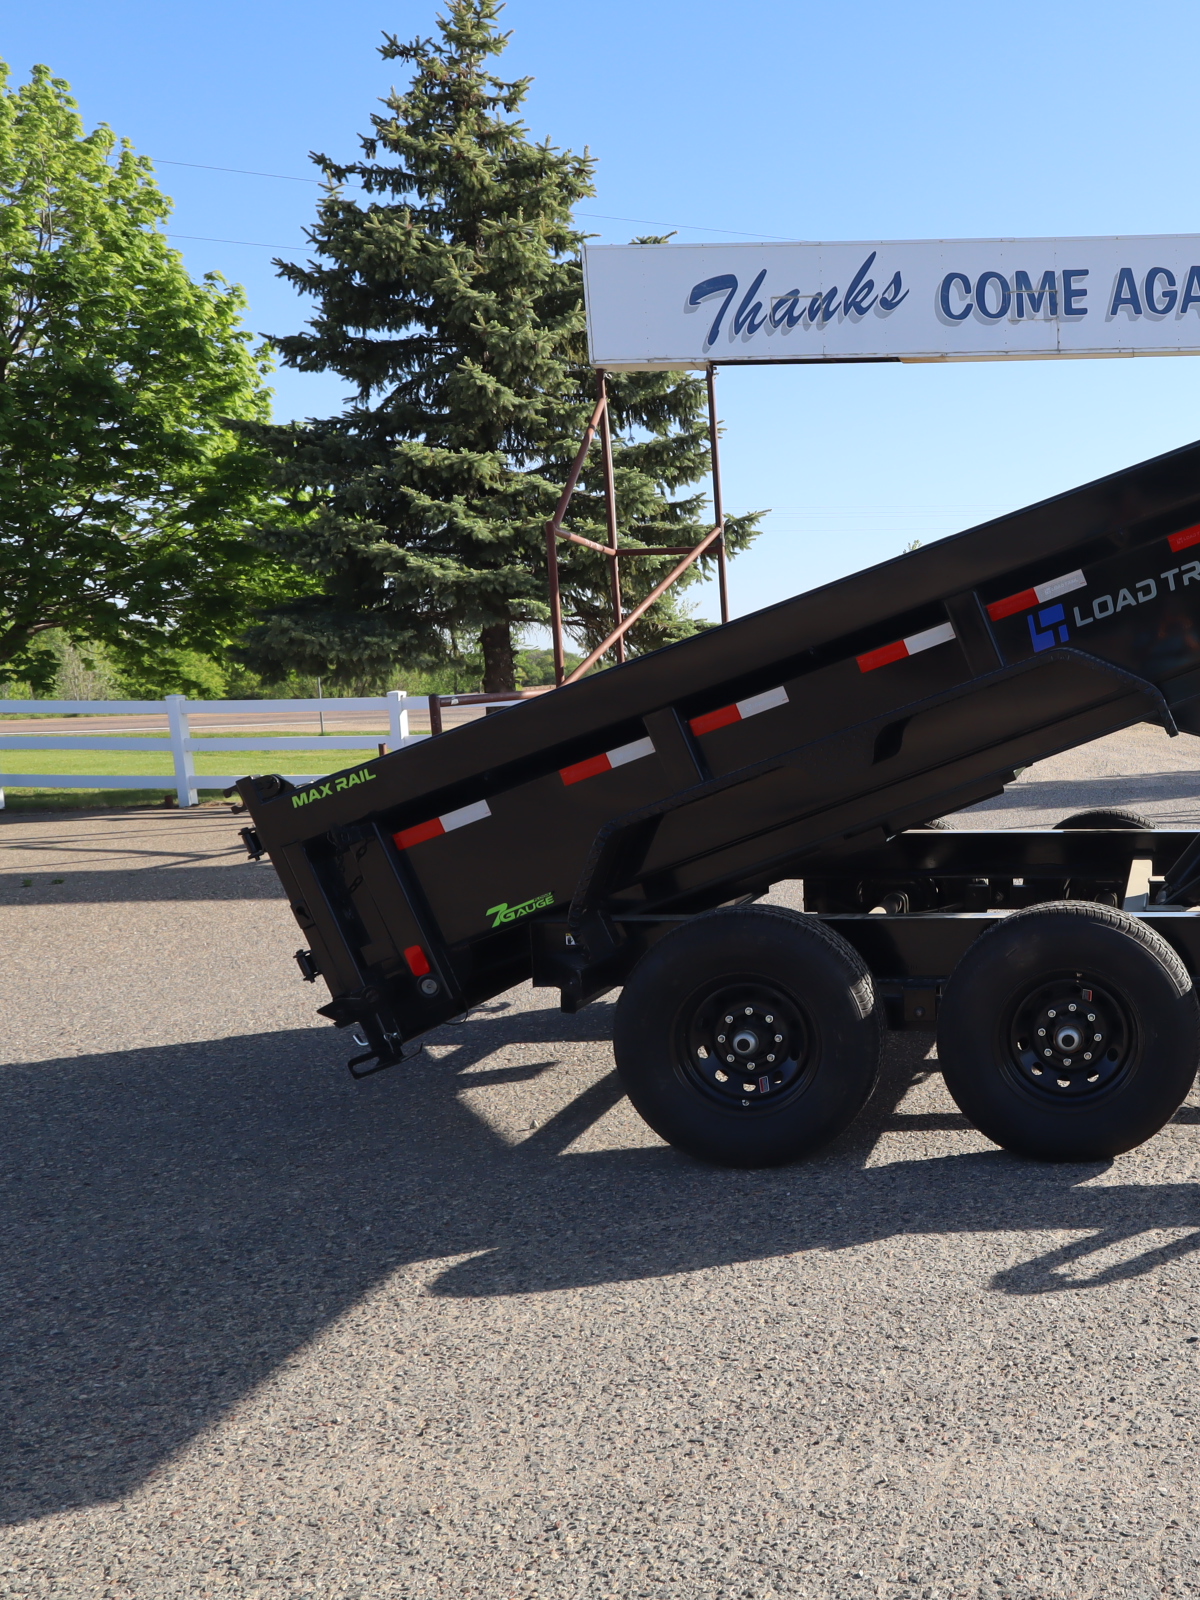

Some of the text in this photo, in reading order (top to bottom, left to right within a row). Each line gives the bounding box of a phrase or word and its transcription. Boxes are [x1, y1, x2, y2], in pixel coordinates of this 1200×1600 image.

[688, 251, 910, 347] Thanks
[940, 267, 1090, 322] COME
[1073, 578, 1157, 628] LOAD
[291, 768, 377, 809] MAX RAIL
